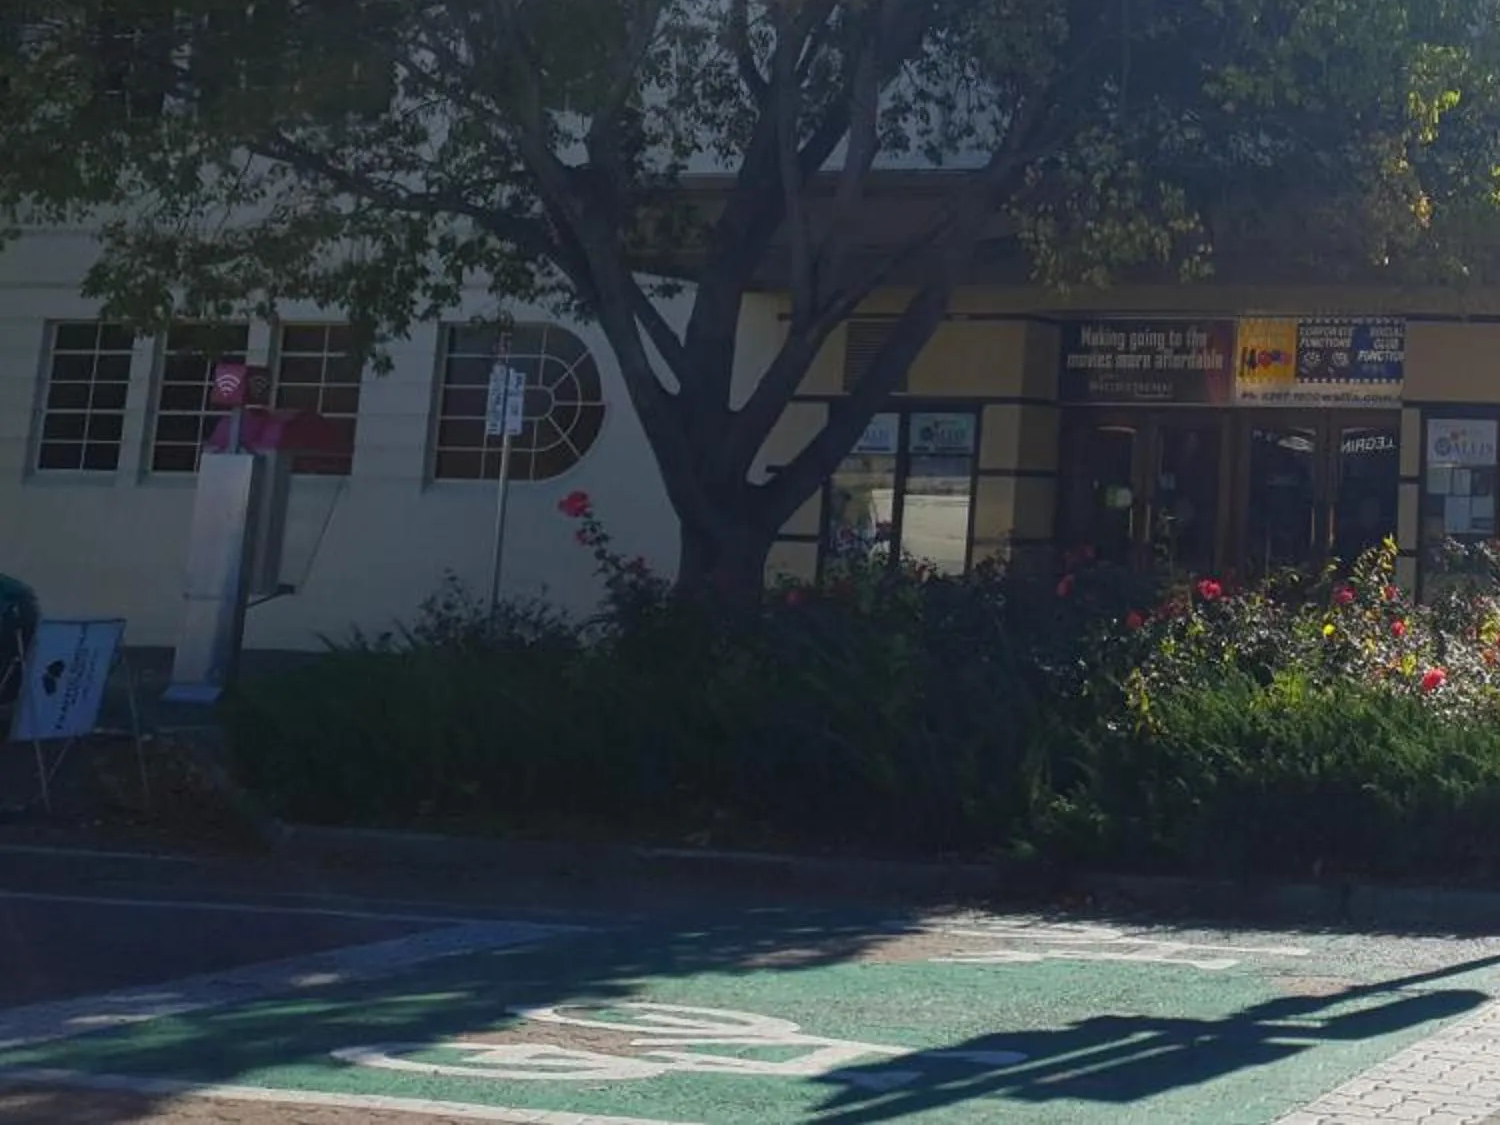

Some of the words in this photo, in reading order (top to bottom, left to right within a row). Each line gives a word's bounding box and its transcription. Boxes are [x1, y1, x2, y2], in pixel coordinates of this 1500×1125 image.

[1080, 326, 1125, 350] Making
[1129, 328, 1166, 350] going
[1169, 329, 1183, 347] to
[1186, 326, 1208, 347] the
[1066, 352, 1112, 369] movies
[1114, 354, 1151, 369] more
[1154, 349, 1224, 369] affordable
